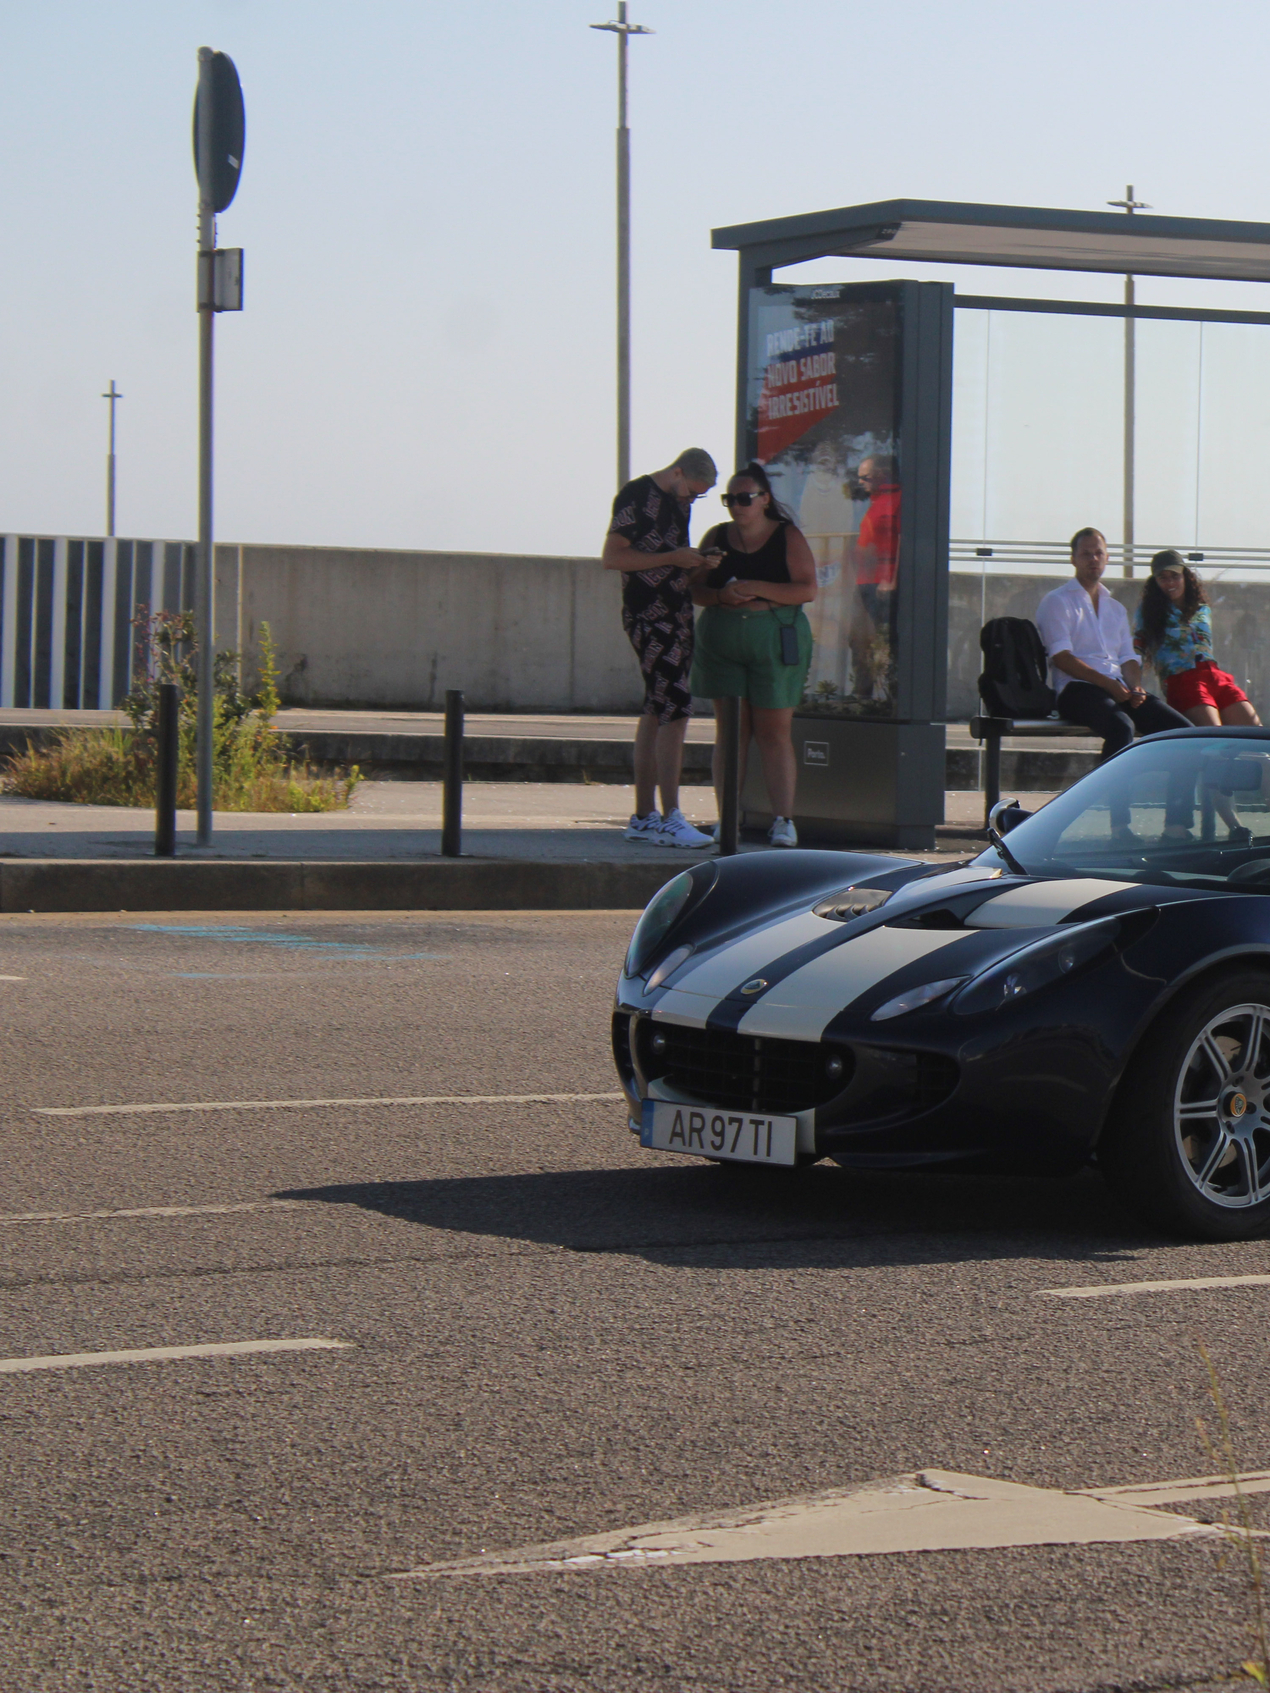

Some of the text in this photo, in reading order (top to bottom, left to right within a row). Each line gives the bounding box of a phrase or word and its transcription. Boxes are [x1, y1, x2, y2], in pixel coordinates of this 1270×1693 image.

[767, 320, 834, 357] RENDE-TE AO
[767, 352, 836, 388] NOVO SABOR
[768, 381, 839, 420] IRRESISTÍVEL
